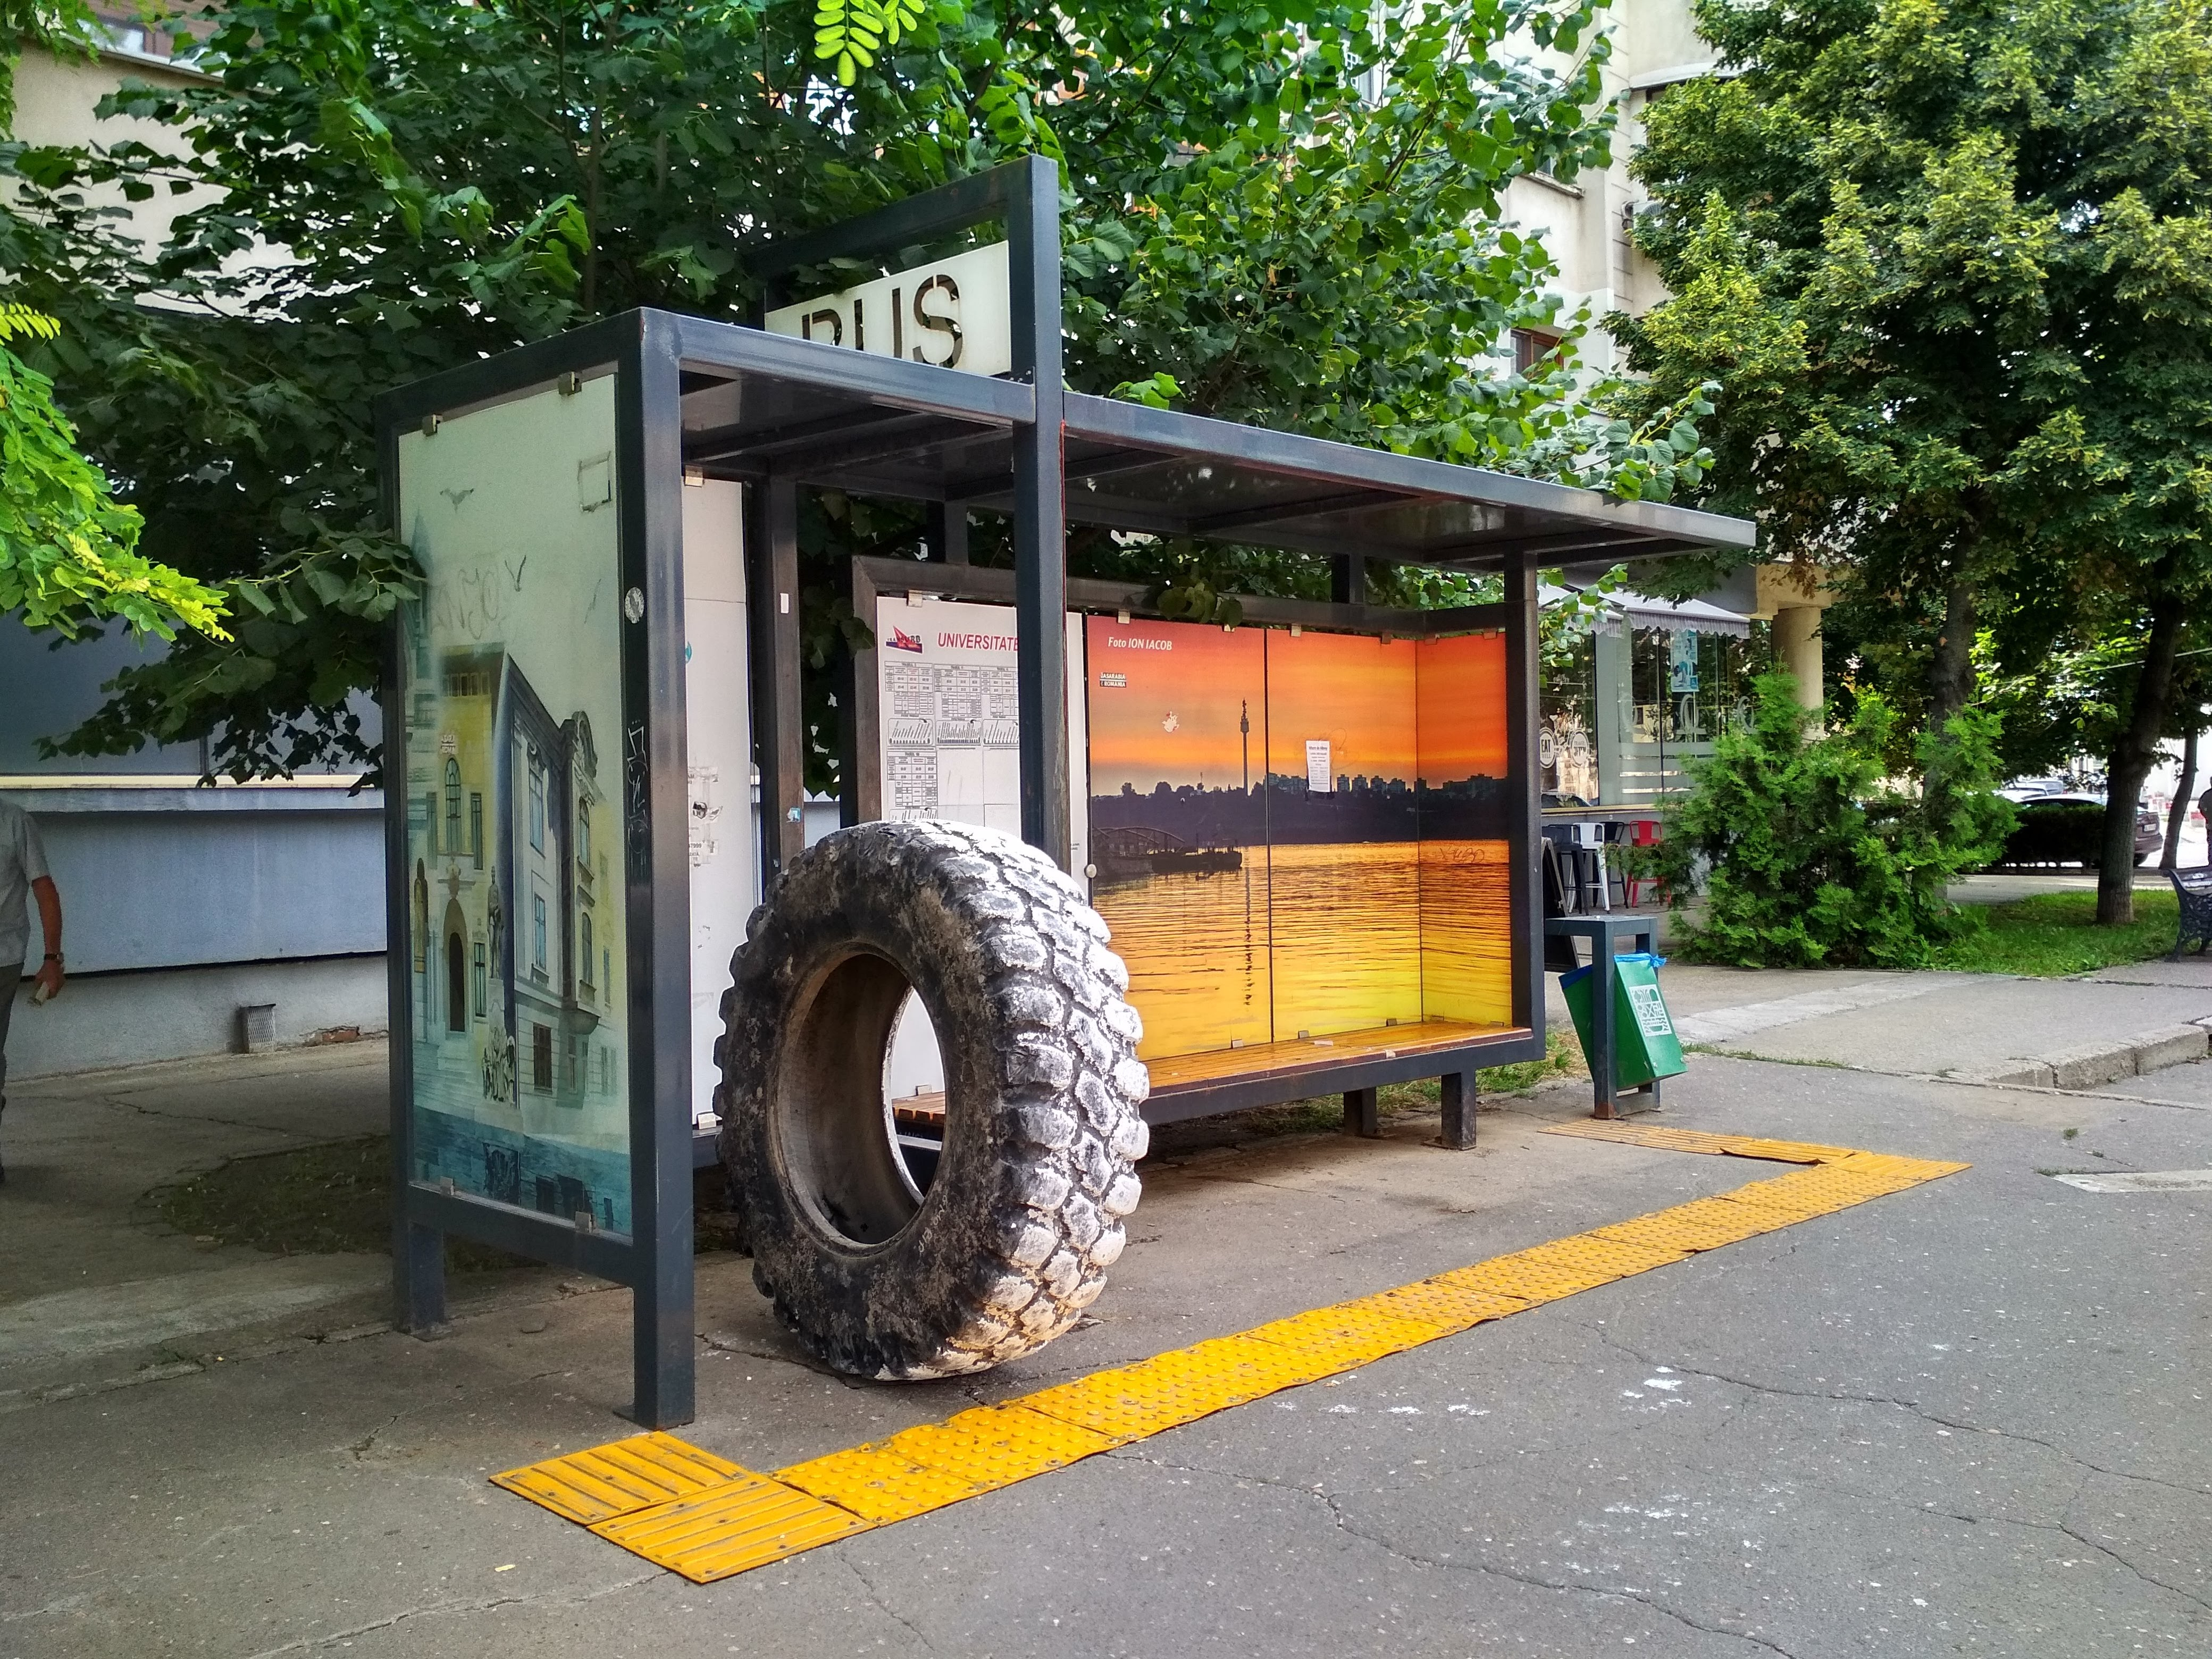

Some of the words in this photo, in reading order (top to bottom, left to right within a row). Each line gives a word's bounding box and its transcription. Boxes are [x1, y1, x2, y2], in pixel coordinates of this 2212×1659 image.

[1108, 636, 1126, 648] Foto
[1128, 638, 1144, 649] ION
[1145, 639, 1172, 651] IACOB
[1541, 739, 1551, 753] EAT
